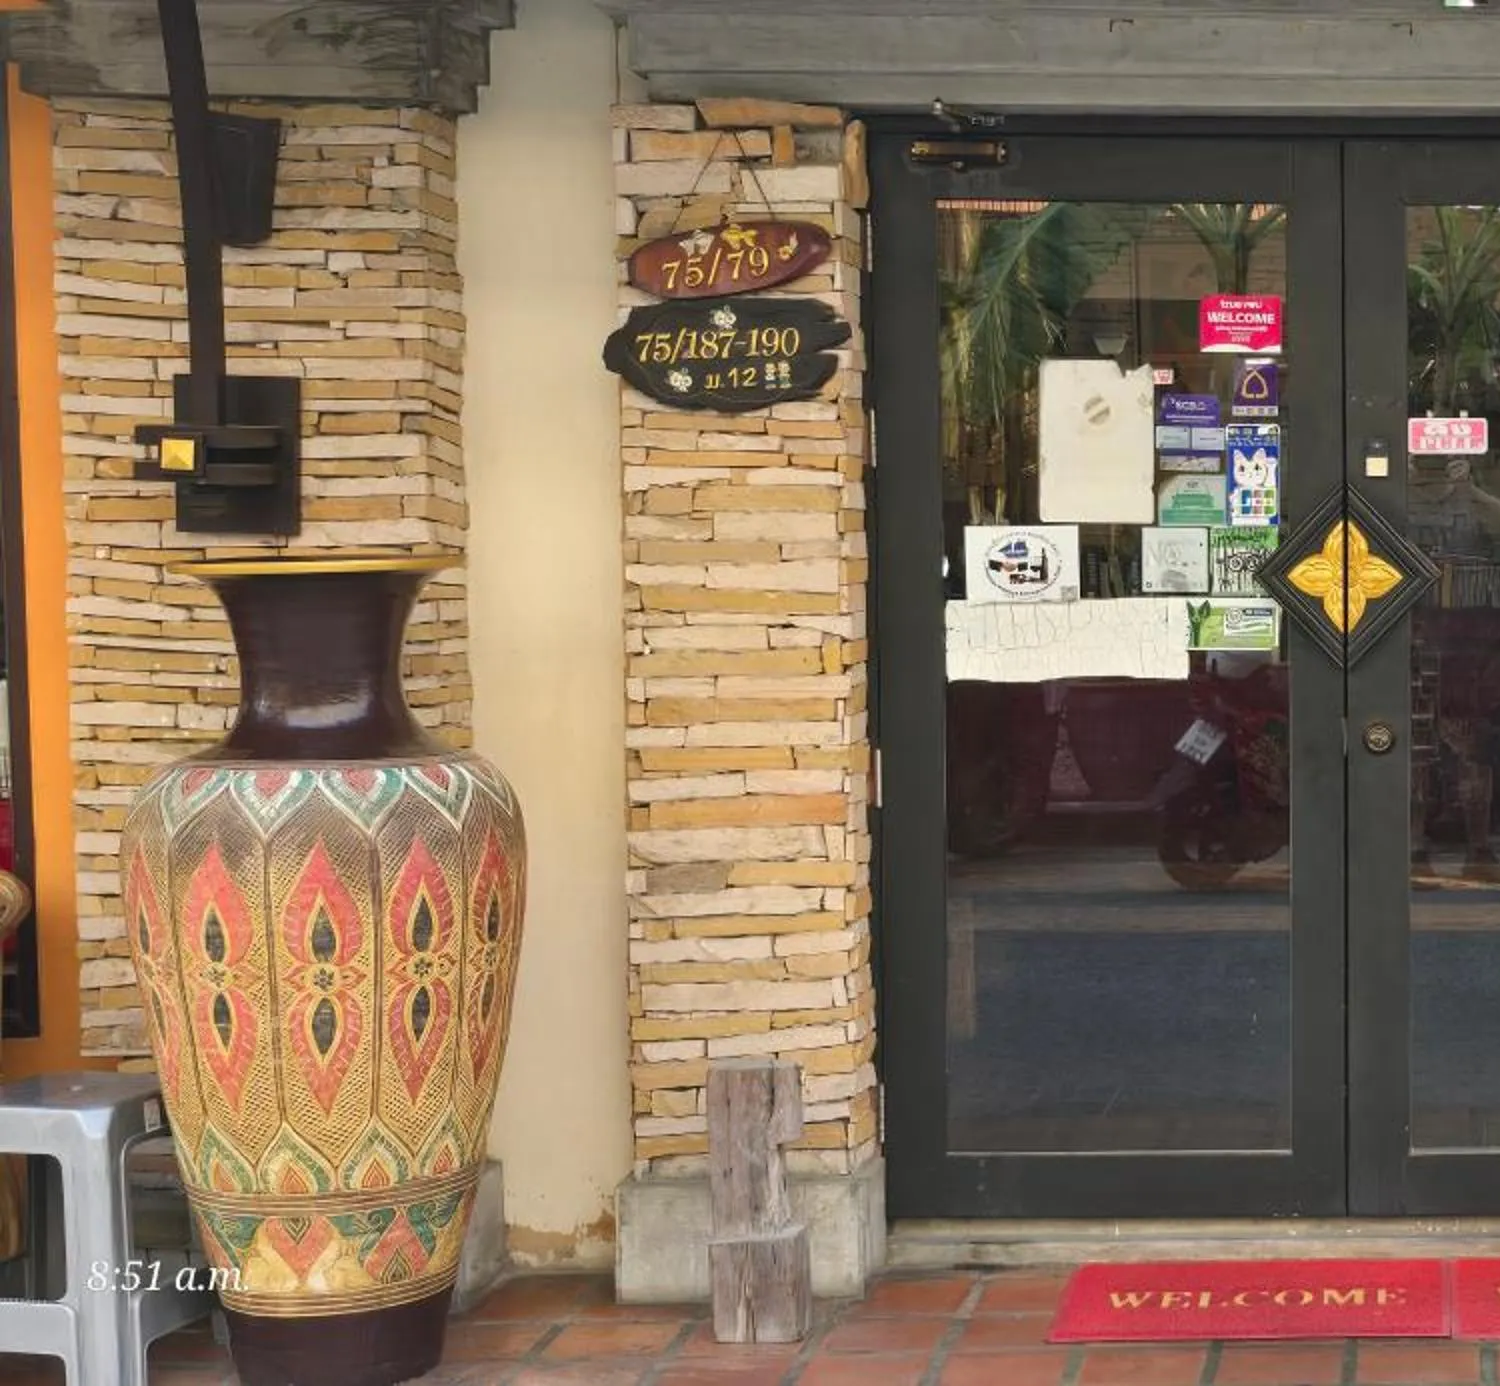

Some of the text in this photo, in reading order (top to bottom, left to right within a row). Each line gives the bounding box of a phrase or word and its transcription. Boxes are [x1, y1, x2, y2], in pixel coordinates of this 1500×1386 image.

[661, 247, 769, 290] 75/79
[1207, 311, 1277, 325] WELCOME
[635, 327, 800, 365] 75/187-190
[1108, 1287, 1407, 1309] WELCOME
